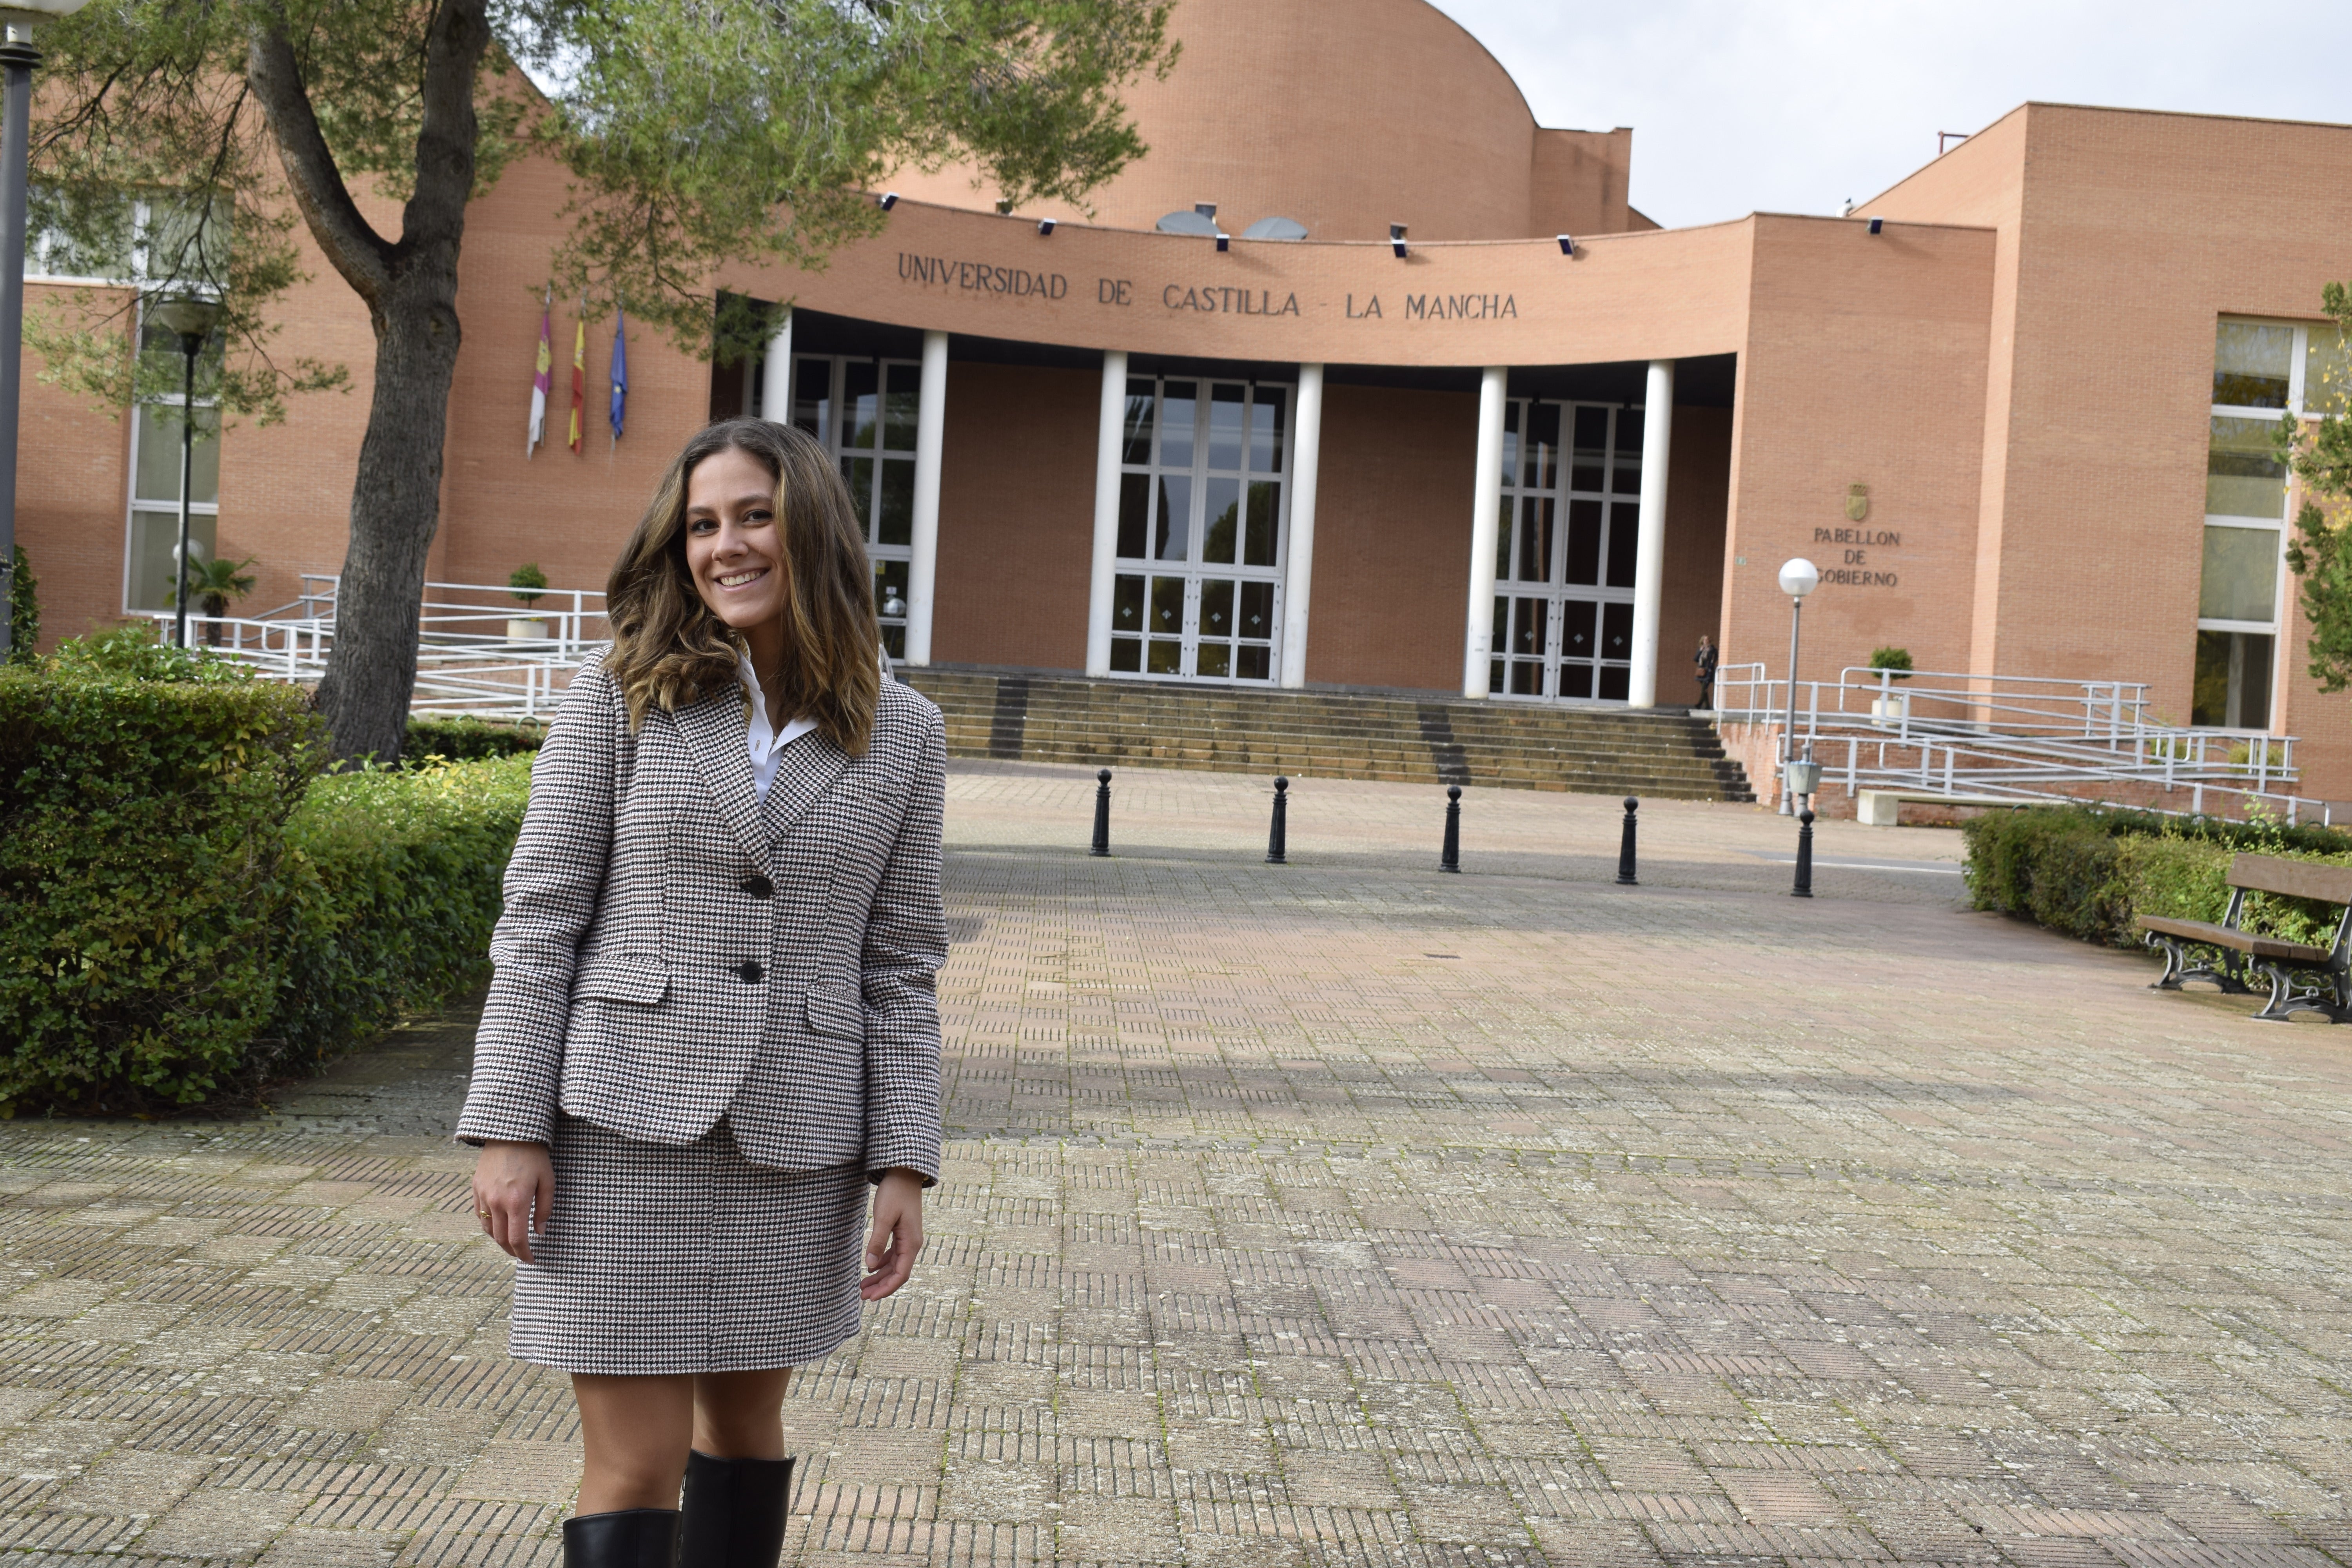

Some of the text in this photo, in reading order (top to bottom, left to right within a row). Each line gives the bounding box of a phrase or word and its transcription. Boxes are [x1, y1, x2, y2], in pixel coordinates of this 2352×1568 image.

[898, 252, 1067, 299] UNIVERSIDAD
[1099, 278, 1132, 305] DE
[1163, 283, 1300, 316] CASTILLA
[1346, 294, 1383, 319] LA
[1406, 294, 1518, 319] MANCHA
[1814, 527, 1900, 546] PABELLON
[1844, 549, 1866, 564] DE
